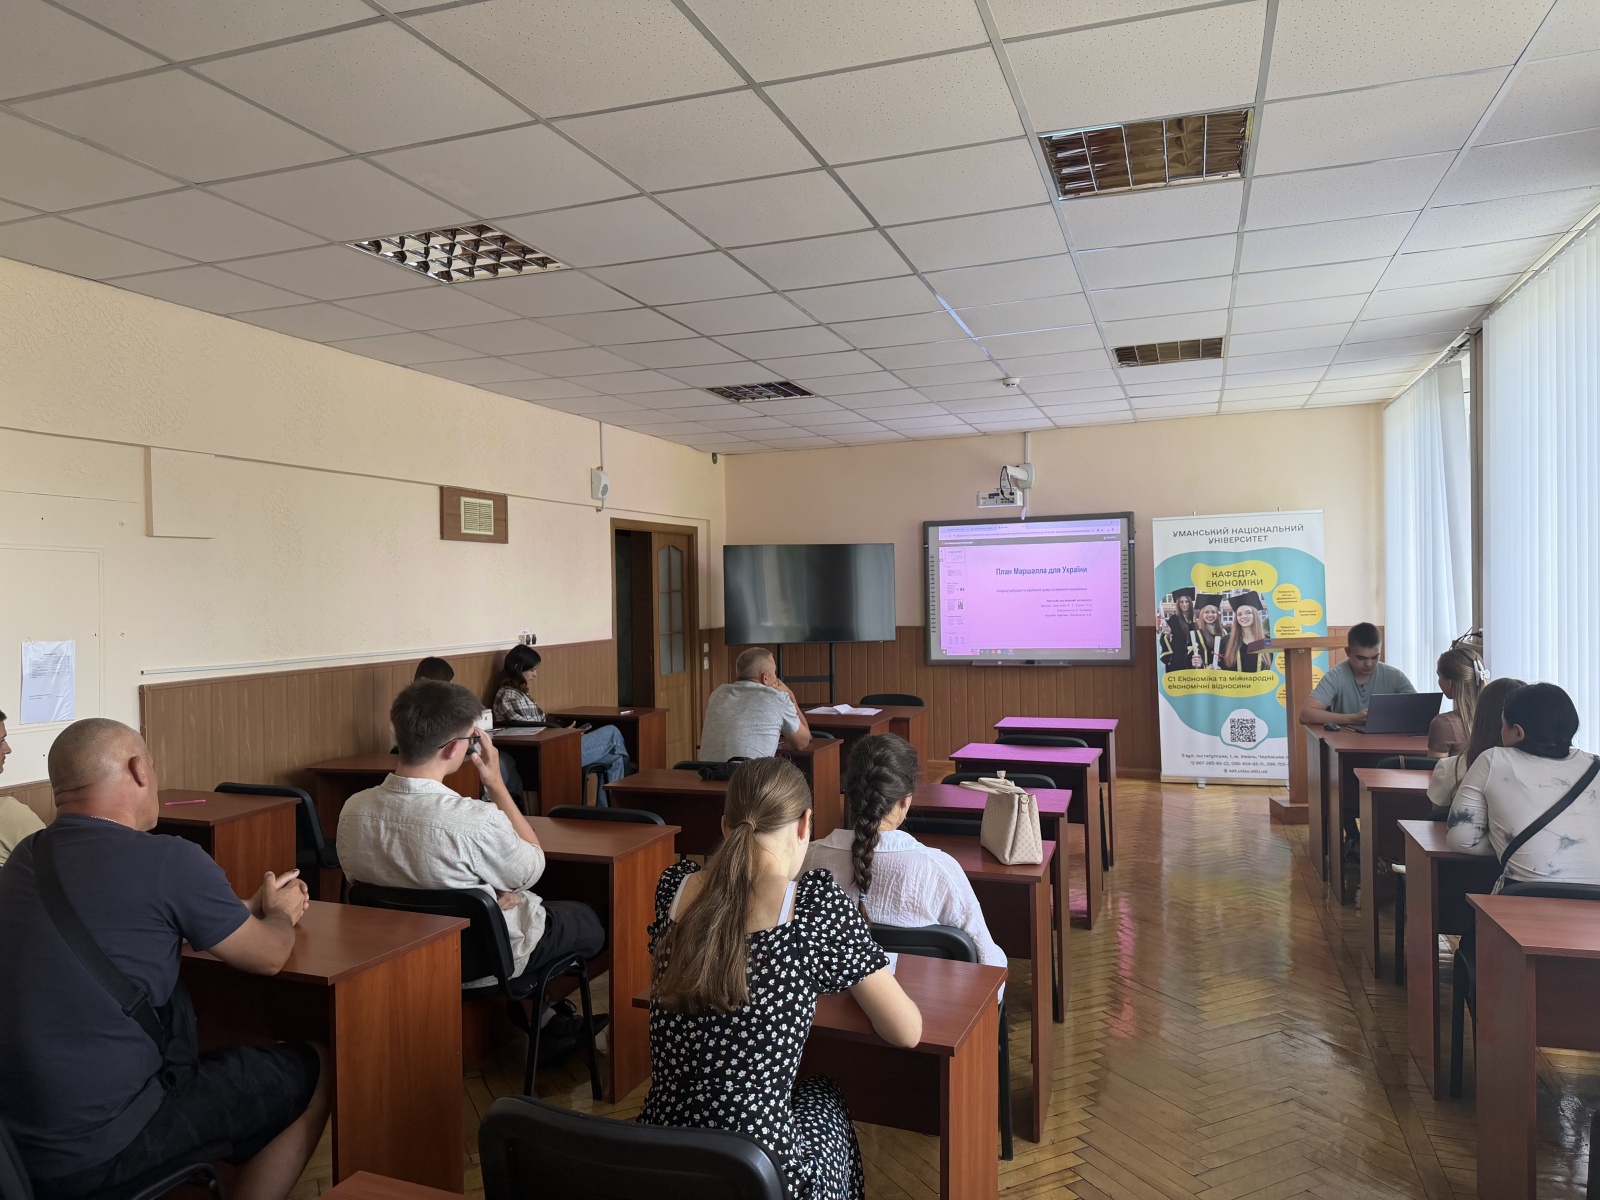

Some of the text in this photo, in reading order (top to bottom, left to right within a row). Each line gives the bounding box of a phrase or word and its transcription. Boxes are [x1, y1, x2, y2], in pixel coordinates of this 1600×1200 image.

[1172, 523, 1304, 538] УМАНСЬКИЙ НАЦІОНАЛЬНИЙ
[1208, 535, 1268, 544] УНІВЕРСИТЕТ
[1013, 567, 1047, 576] Маршалла
[1062, 566, 1088, 574] України
[1211, 569, 1257, 578] КАФЕДРА
[1205, 578, 1263, 588] ЕКОНОМІКИ
